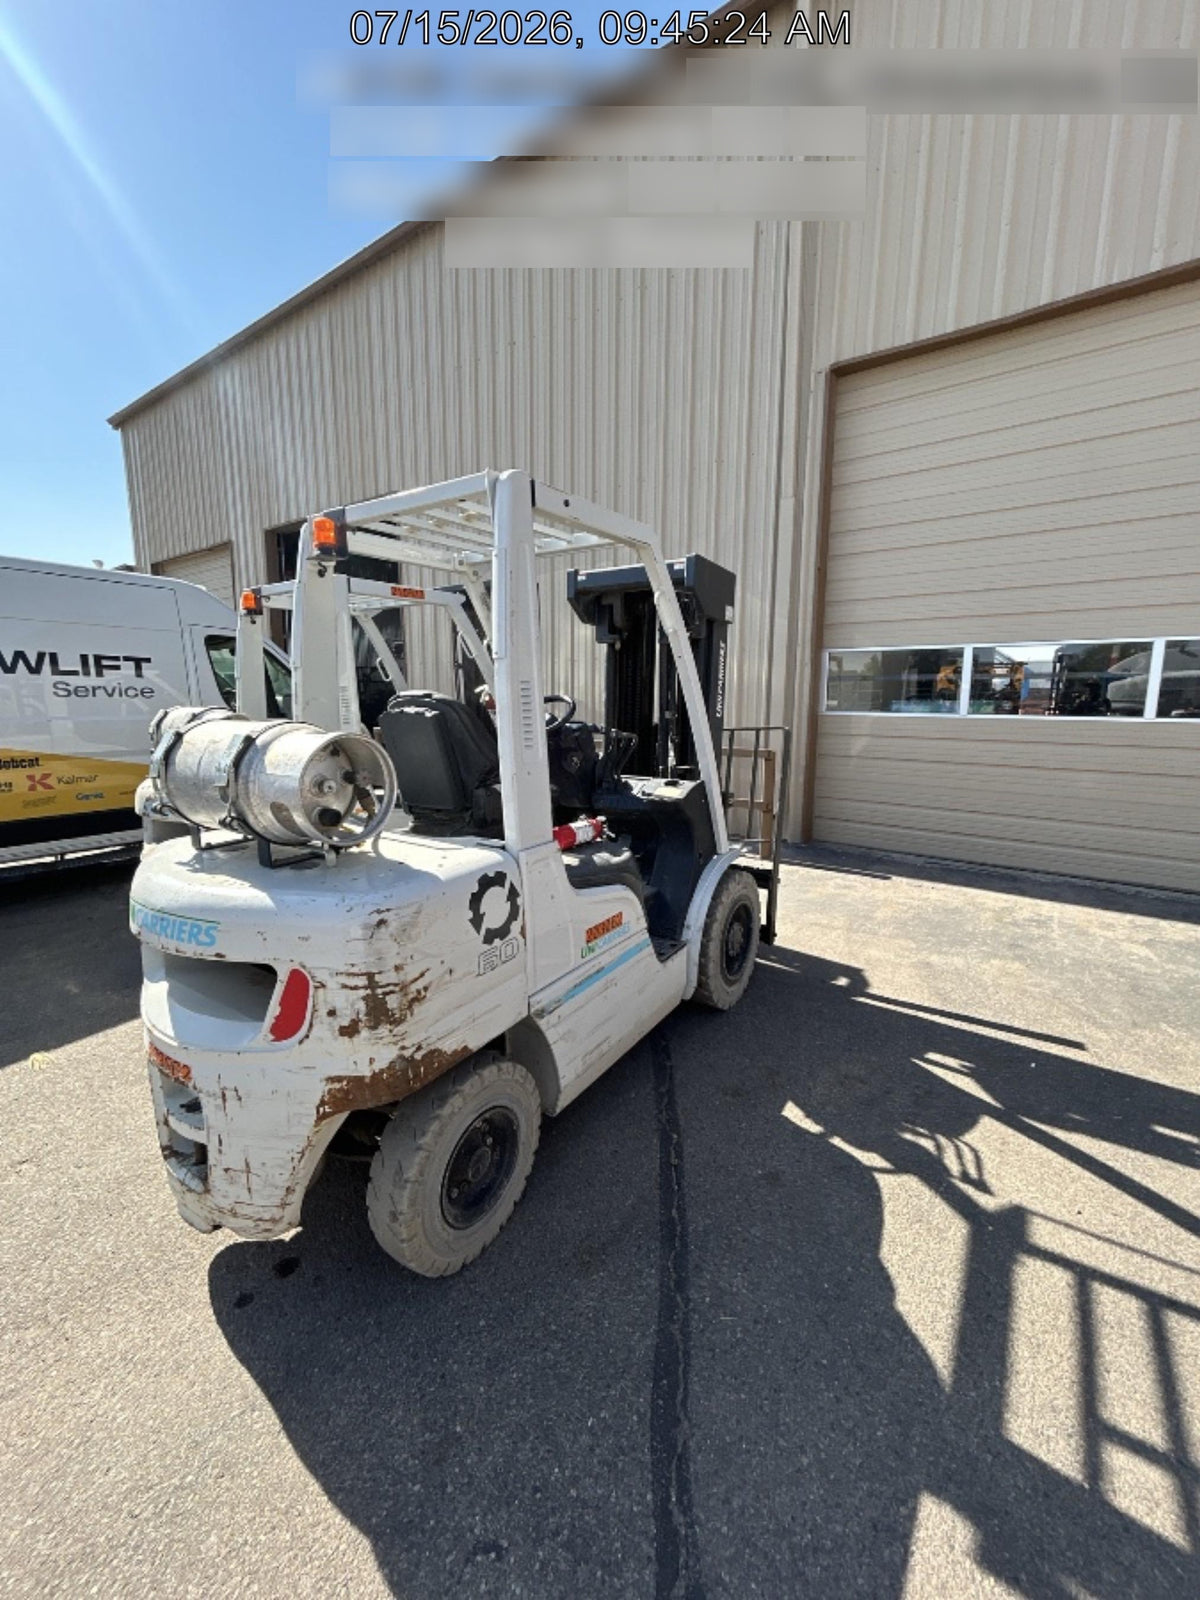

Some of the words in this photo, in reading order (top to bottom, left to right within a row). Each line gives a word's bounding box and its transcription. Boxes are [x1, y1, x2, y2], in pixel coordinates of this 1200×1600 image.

[0, 650, 152, 678] WLIFT
[52, 680, 155, 699] Service
[0, 756, 40, 770] obcat
